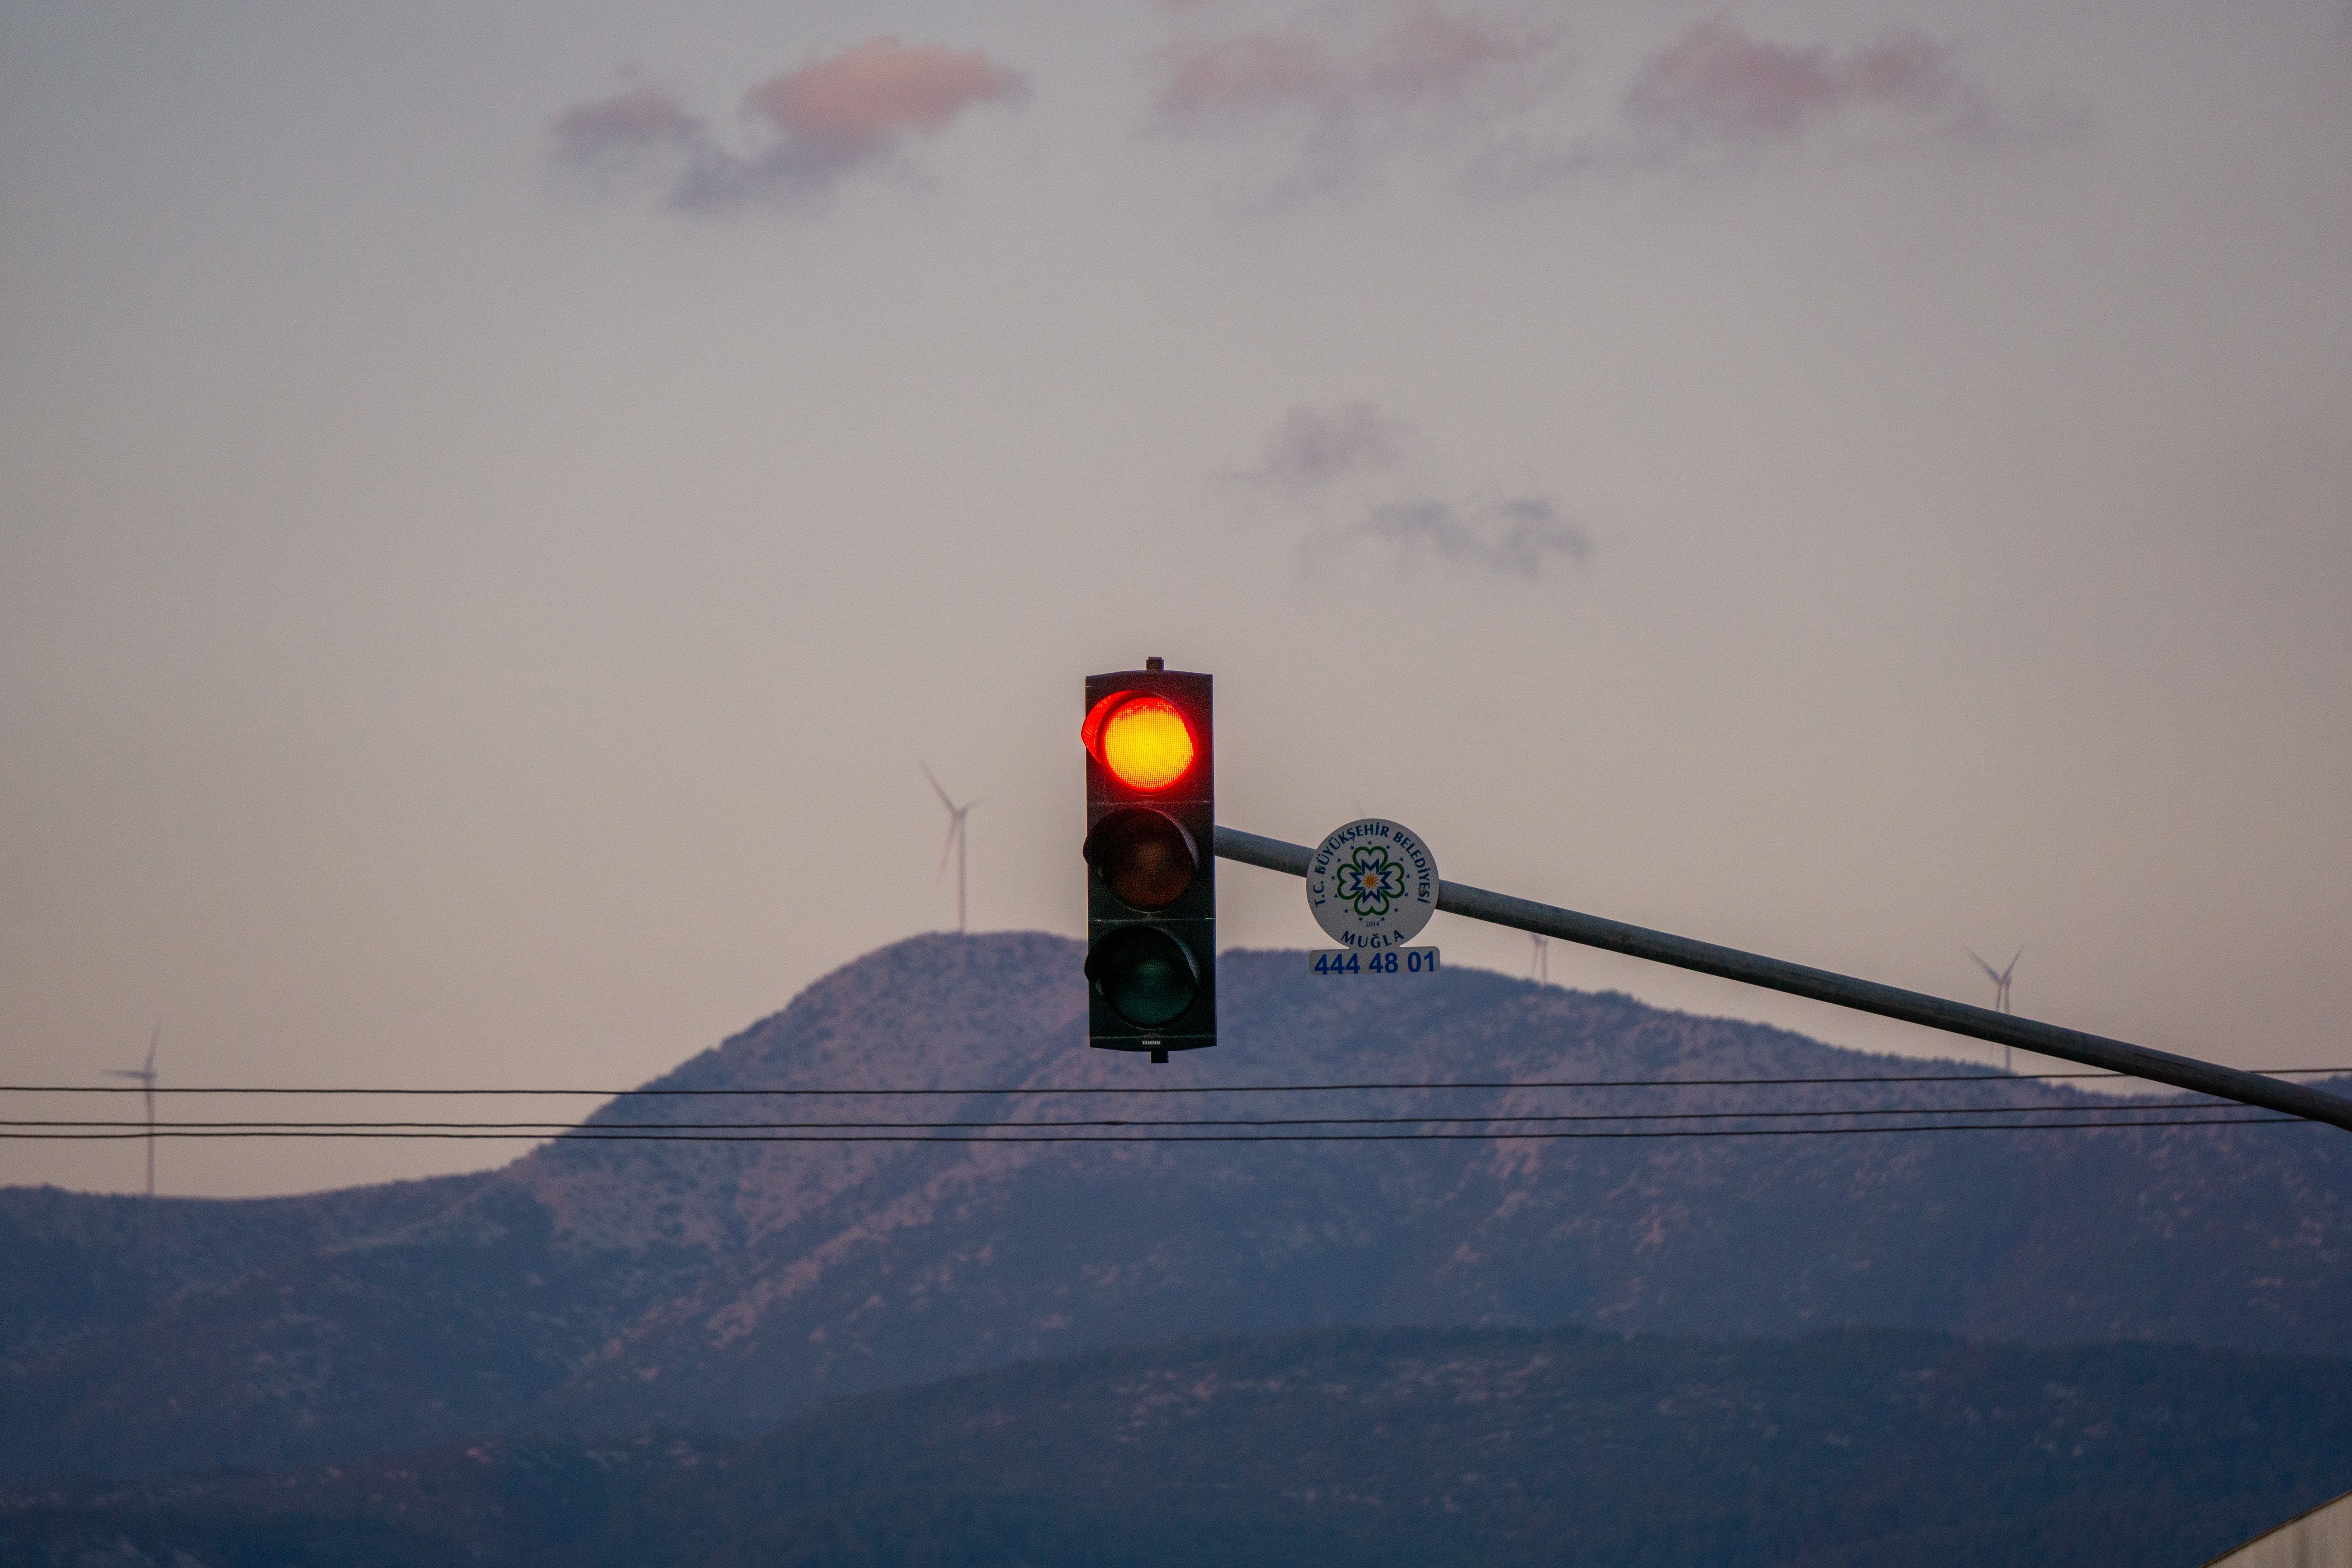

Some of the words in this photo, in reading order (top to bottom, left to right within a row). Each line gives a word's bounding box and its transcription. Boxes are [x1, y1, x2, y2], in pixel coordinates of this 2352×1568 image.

[1314, 822, 1390, 875] BÜYÜKŞEHİR
[1393, 831, 1430, 904] BELEDİYESİ
[1313, 880, 1326, 908] T.C.
[1340, 929, 1405, 948] MUĞLA
[1314, 953, 1361, 975] 444
[1368, 952, 1399, 973] 48
[1407, 950, 1434, 972] 01
